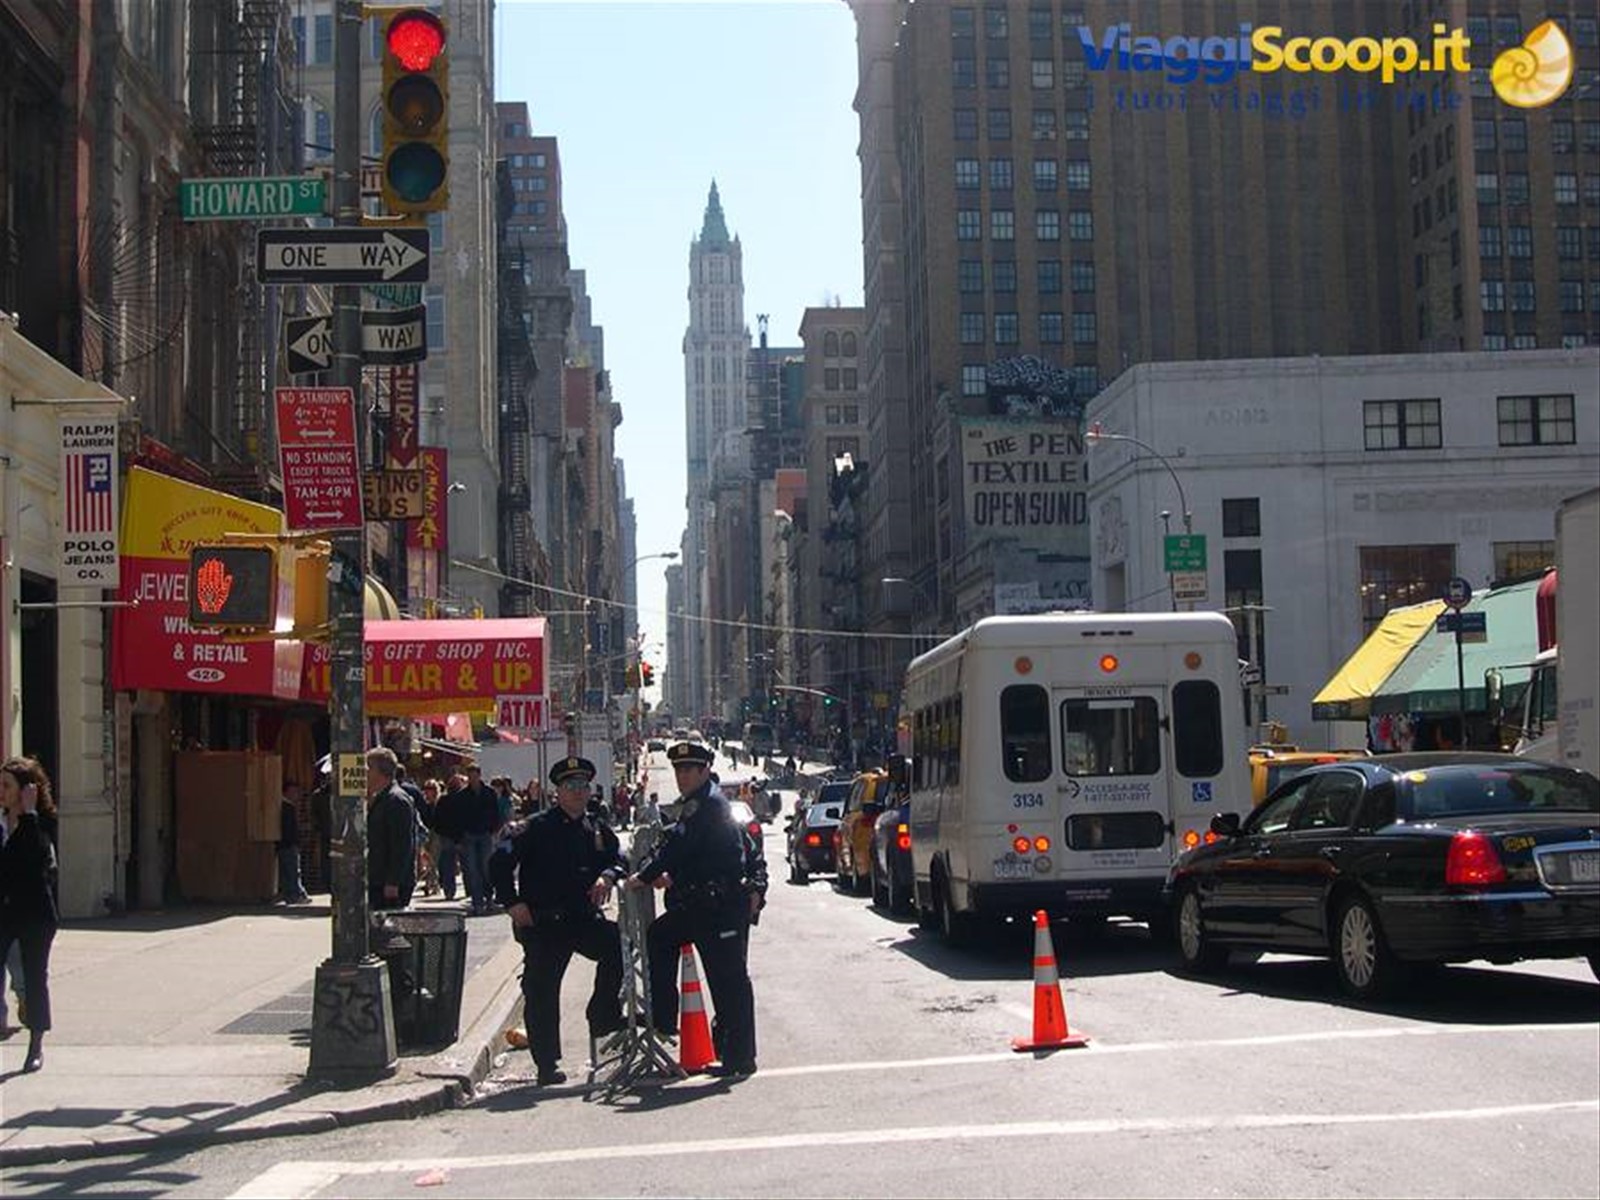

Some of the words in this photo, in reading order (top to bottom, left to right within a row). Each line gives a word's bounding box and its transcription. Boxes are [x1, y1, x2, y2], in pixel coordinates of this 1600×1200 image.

[189, 183, 294, 215] HOWARD
[300, 181, 321, 198] ST
[281, 246, 327, 267] ONE
[360, 246, 408, 267] WAY
[307, 329, 335, 355] ON
[378, 326, 415, 349] WAY
[280, 391, 295, 404] NO
[300, 391, 348, 405] STANDING
[62, 425, 115, 437] RALPH
[62, 438, 115, 448] LAUREN
[982, 436, 1019, 458] THE
[1029, 434, 1088, 456] PEN
[286, 451, 300, 464] NO
[303, 451, 352, 464] STANDING
[967, 461, 1077, 484] TEXTILE
[363, 474, 419, 494] ETING
[363, 497, 408, 516] RDS
[974, 491, 1026, 527] OPEN
[1029, 491, 1090, 526] SUND
[64, 540, 115, 553] POLO
[64, 555, 115, 566] JEANS
[77, 569, 104, 580] CO.
[173, 643, 185, 661] &
[193, 644, 249, 663] RETAIL
[384, 643, 425, 661] GIFT
[435, 642, 484, 660] SHOP
[494, 641, 531, 658] INC.
[457, 662, 478, 692] &
[492, 660, 533, 690] UP
[500, 701, 541, 728] ATM
[1013, 793, 1044, 808] 3134
